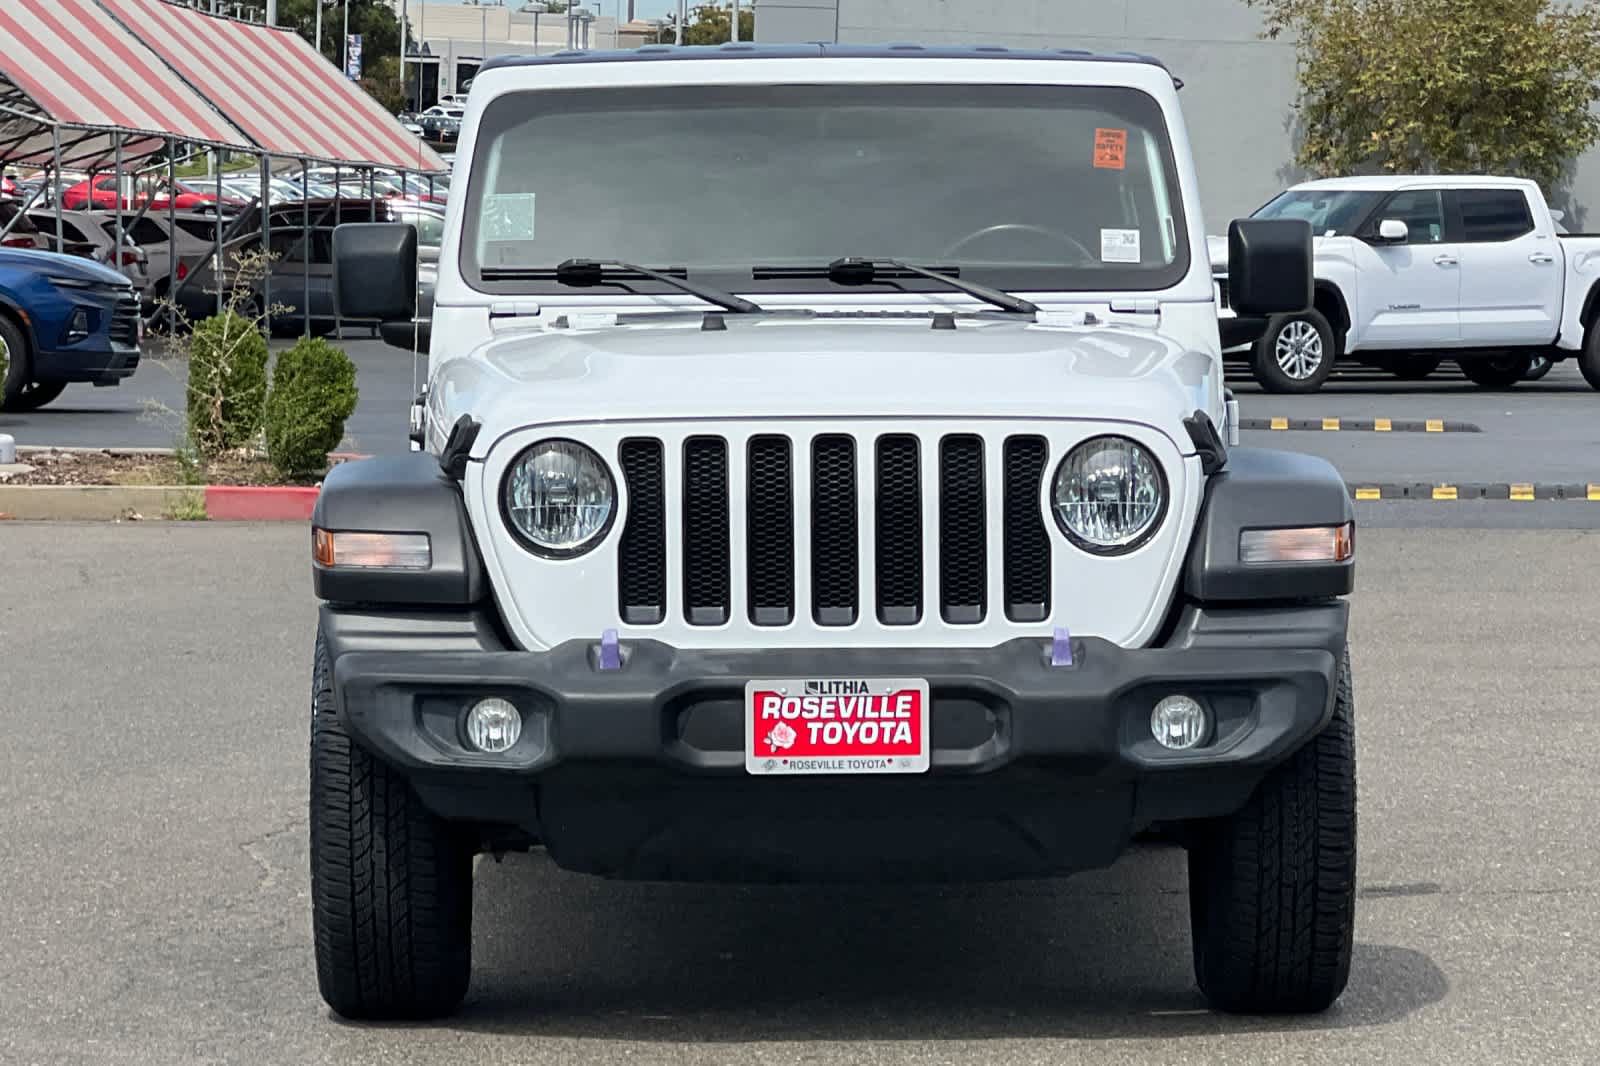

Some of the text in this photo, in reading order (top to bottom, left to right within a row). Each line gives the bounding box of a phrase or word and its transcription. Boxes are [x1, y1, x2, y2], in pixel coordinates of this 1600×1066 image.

[820, 681, 869, 695] LITHIA
[761, 695, 913, 719] ROSEVILLE
[807, 721, 912, 745] TOYOTA
[789, 759, 886, 770] ROSEVILLE TOYOTA
